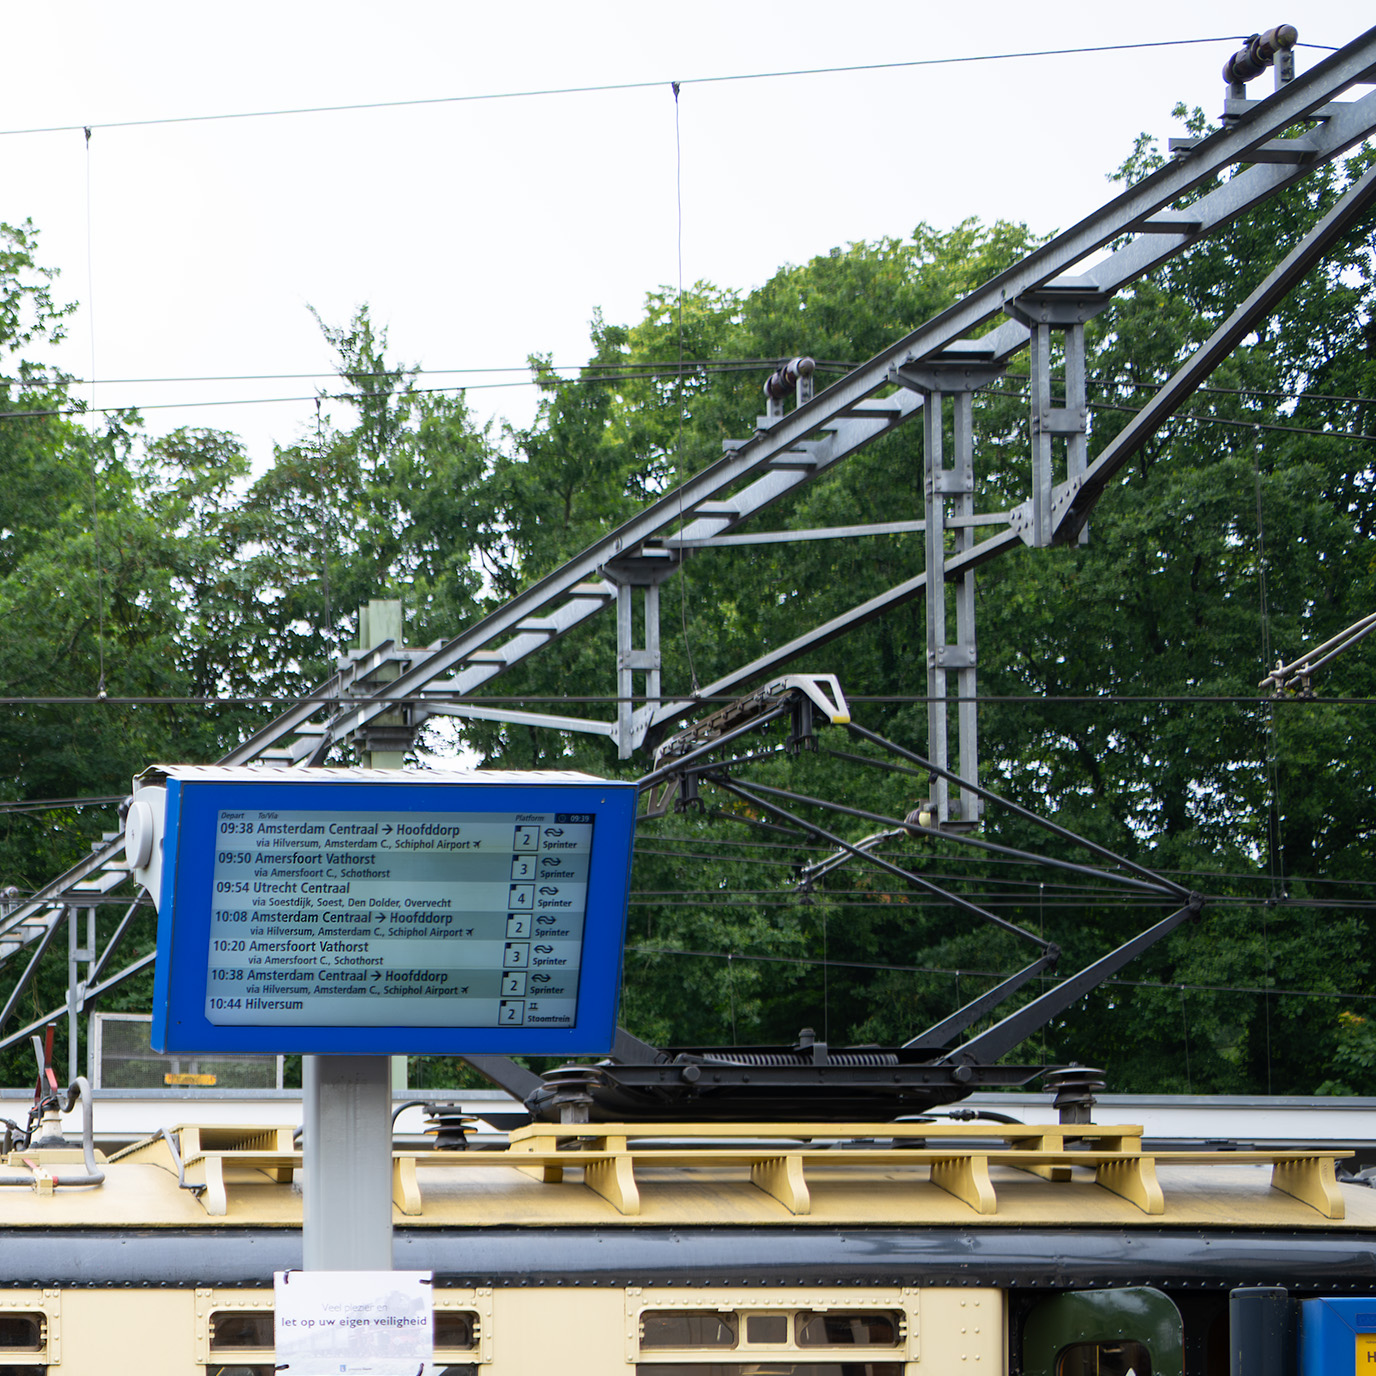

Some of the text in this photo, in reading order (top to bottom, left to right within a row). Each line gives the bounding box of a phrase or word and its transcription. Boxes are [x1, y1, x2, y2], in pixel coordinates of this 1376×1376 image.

[221, 812, 245, 820] Depart
[258, 812, 279, 820] To/Via
[515, 814, 545, 822] Platform
[220, 822, 460, 838] 09:38 Amsterdam Centraal Hoofddorp
[256, 838, 470, 851] via Hilversum, Amsterdam C., Schiphol Airport
[522, 834, 578, 850] 2 Sprinter
[218, 852, 376, 865] 09:50 Amersfoort Vathorst
[254, 868, 391, 879] via Amersfoort C., Schothorst
[520, 863, 575, 880] 3 Sprinter
[216, 881, 351, 894] 09:54 Utrecht Centraal
[252, 897, 452, 909] via Soestdijk, Soest, Den Dolder, Overvecht
[517, 893, 572, 909] 4 Sprinter
[215, 910, 453, 927] 10:08 Amsterdam Centraal Hoofddorp
[250, 926, 463, 939] via Hilversum, Amsterdam C., Schiphol Airport
[515, 922, 570, 938] 2 Sprinter
[214, 939, 369, 953] 10:20 Amersfoort Vathorst
[248, 955, 384, 966] via Amersfoort C., Schothorst
[512, 951, 567, 967] 3 Sprinter
[211, 969, 448, 985] 10:38 Amsterdam Centraal Hoofddorp
[246, 984, 459, 997] via Hilversum, Amsterdam C., Schiphol Airport
[510, 980, 565, 996] 2 Sprinter
[209, 998, 304, 1010] 10:44 Hilversum
[508, 1008, 571, 1023] 2 Stoomtrein
[322, 1302, 342, 1312] Veel
[376, 1304, 388, 1312] en
[281, 1316, 427, 1329] let op uw eigen veiligheid
